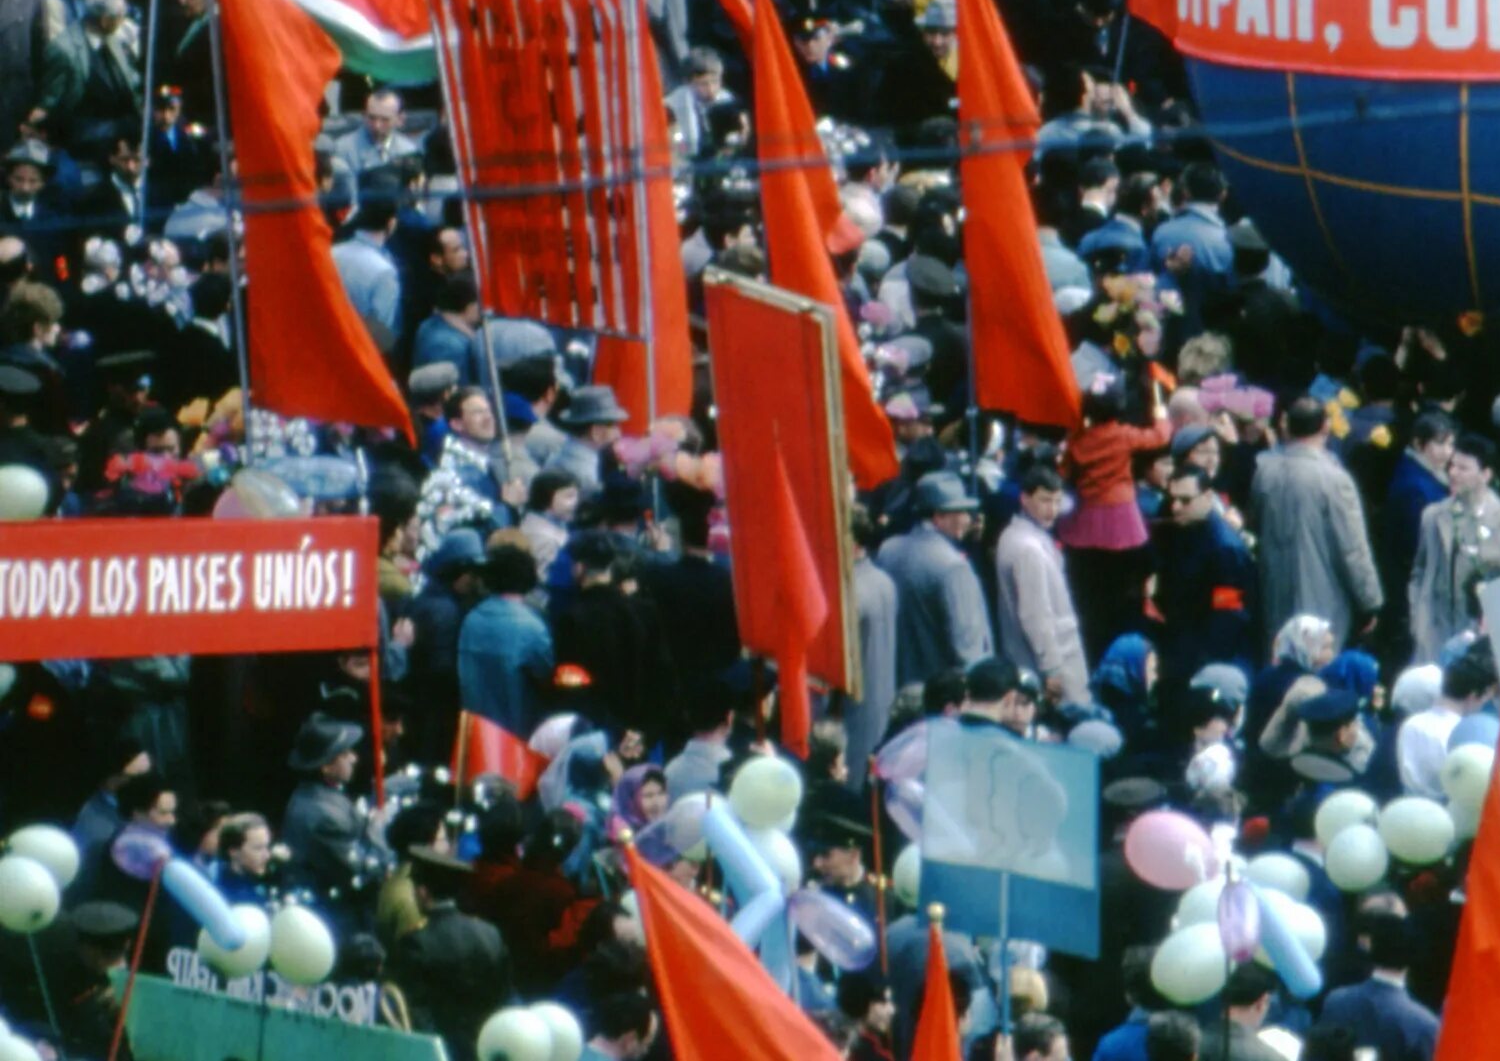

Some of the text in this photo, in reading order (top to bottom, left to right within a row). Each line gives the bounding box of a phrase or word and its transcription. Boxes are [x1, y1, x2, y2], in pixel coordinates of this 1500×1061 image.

[89, 555, 137, 617] LOS
[147, 552, 243, 614] PAISES
[253, 534, 355, 610] UNÍOS!
